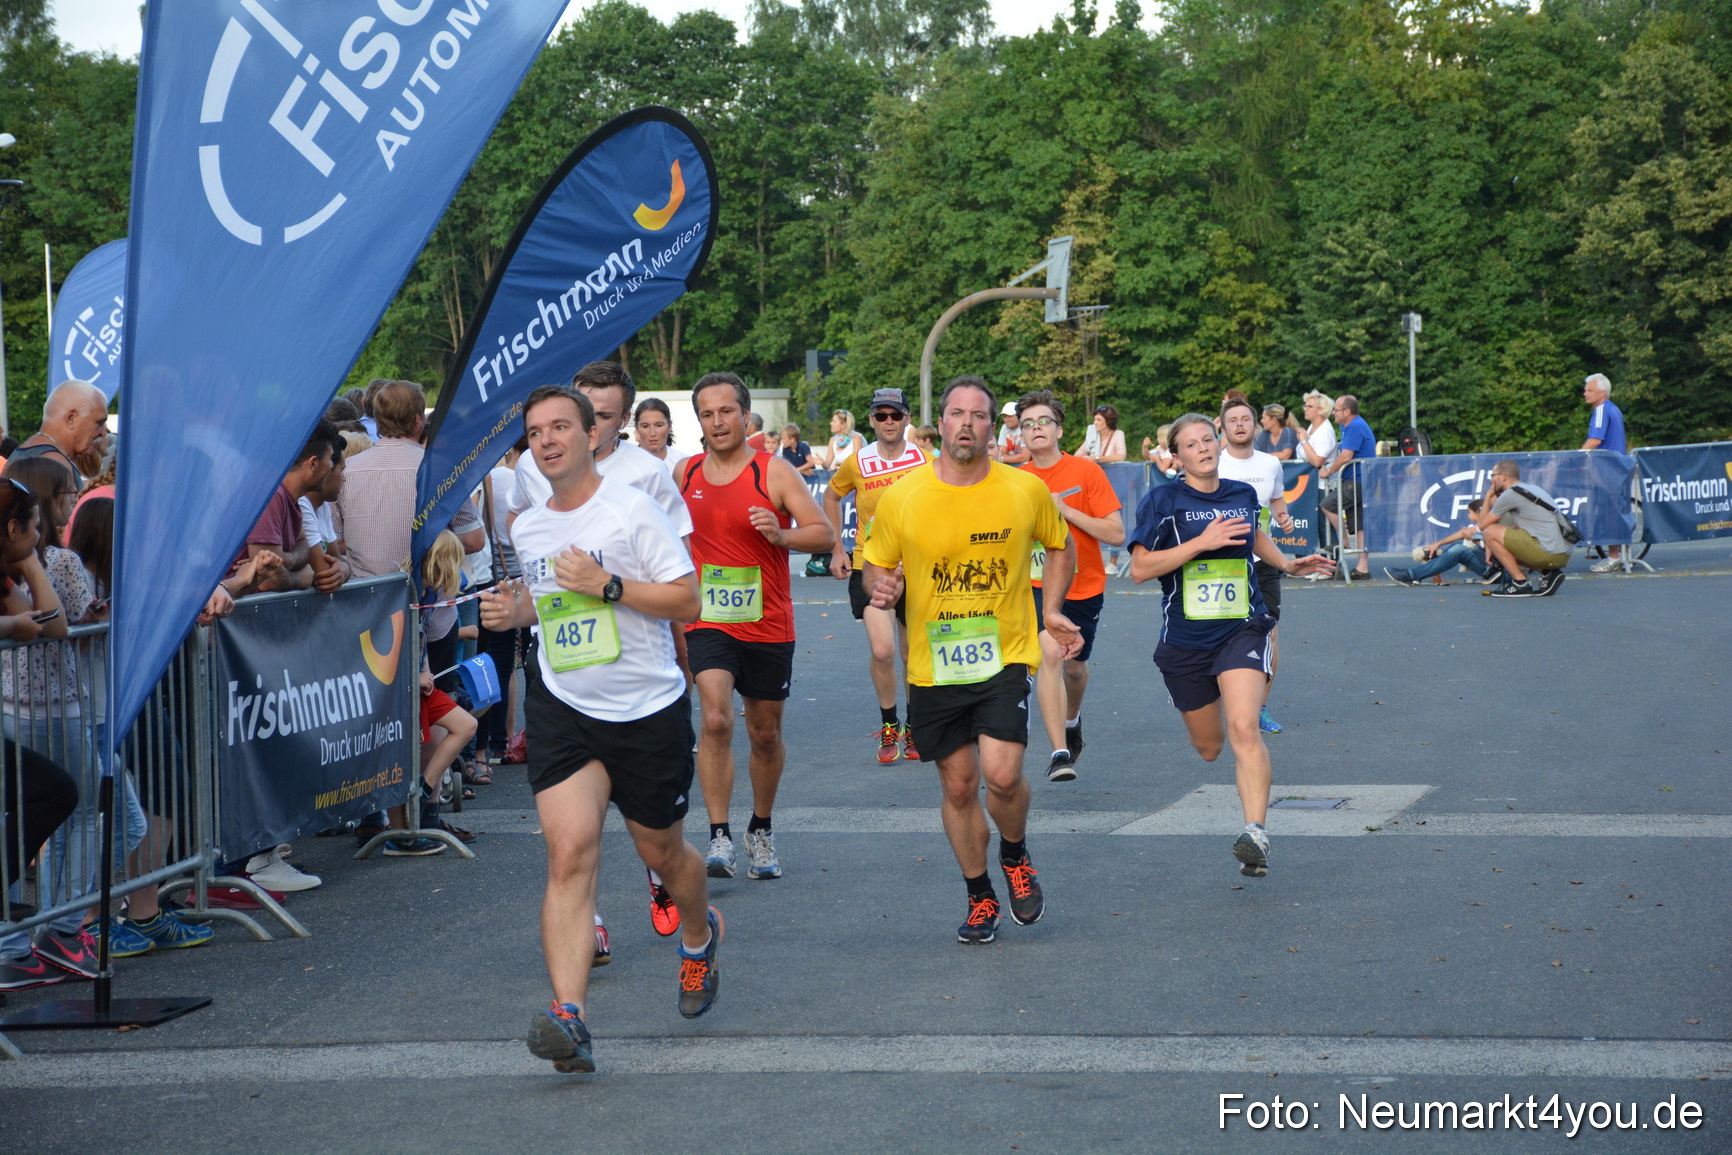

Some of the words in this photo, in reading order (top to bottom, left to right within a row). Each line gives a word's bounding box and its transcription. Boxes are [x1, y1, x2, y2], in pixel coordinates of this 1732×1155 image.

[582, 290, 625, 330] Druck
[626, 268, 655, 293] und
[652, 222, 702, 273] Medien
[472, 237, 643, 403] Frischmann
[864, 477, 894, 491] MAX
[1643, 475, 1728, 503] Frischmann
[1695, 500, 1714, 514] Druck
[1715, 499, 1730, 512] und
[970, 532, 999, 542] swn
[707, 588, 756, 607] 1367
[1197, 583, 1236, 602] 376
[938, 611, 965, 620] Alles
[555, 618, 597, 648] 487
[938, 641, 994, 666] 1483
[228, 669, 373, 746] Frischmann
[320, 730, 351, 766] Druck
[354, 724, 373, 757] und
